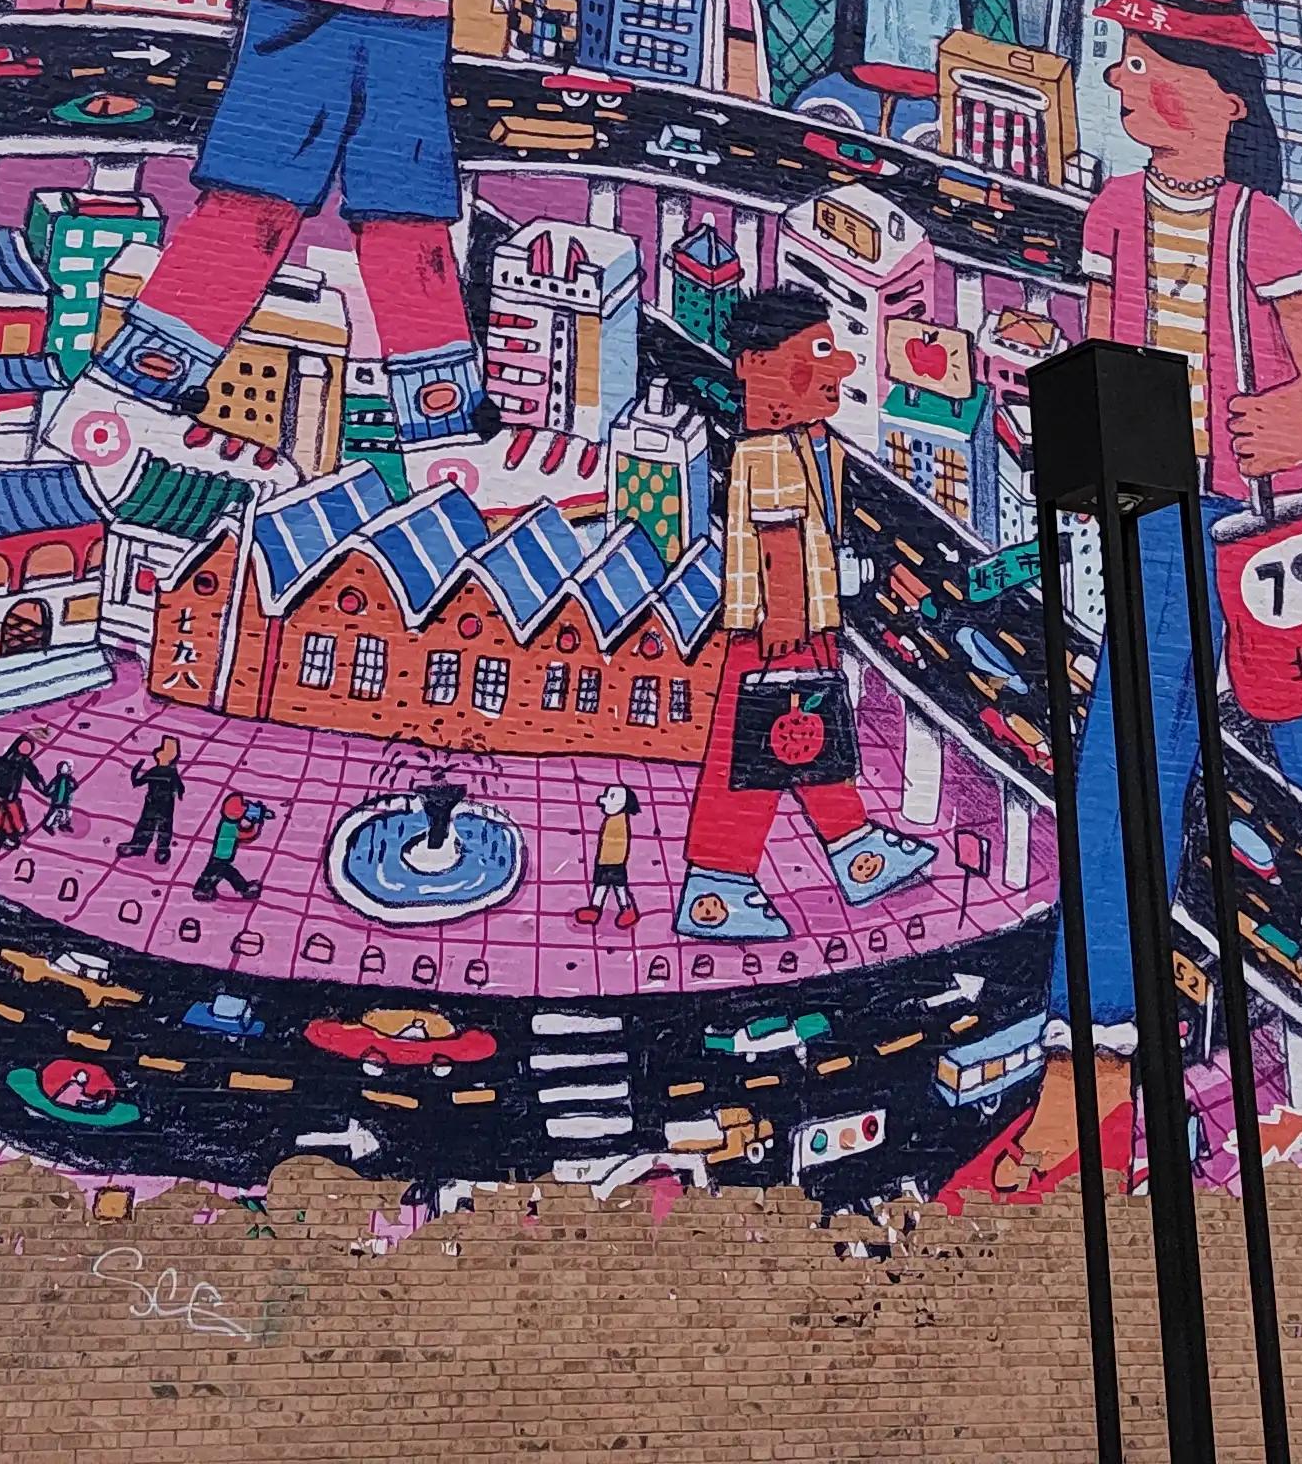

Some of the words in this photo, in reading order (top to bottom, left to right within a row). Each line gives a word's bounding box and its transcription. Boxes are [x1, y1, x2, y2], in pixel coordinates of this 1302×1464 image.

[1116, 0, 1173, 31] 北京
[821, 207, 861, 249] 电气
[161, 607, 203, 691] 七九八
